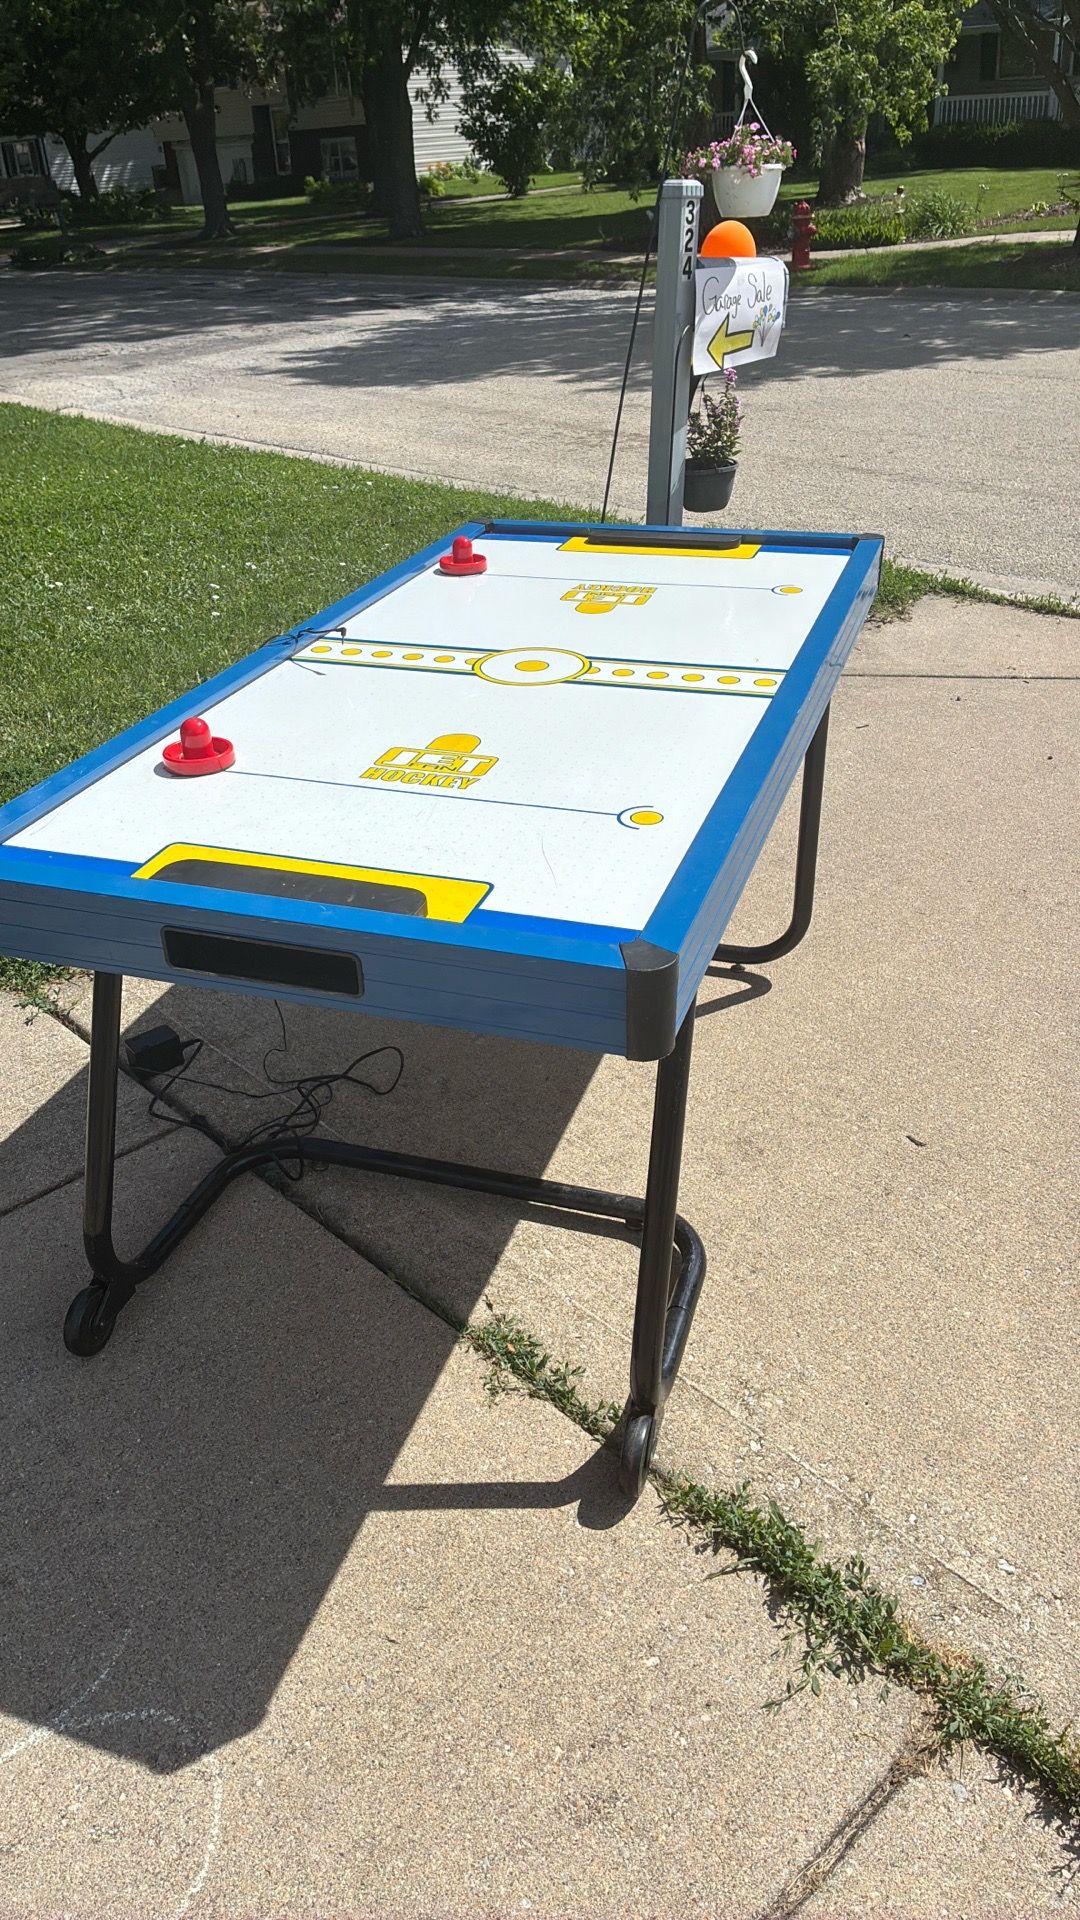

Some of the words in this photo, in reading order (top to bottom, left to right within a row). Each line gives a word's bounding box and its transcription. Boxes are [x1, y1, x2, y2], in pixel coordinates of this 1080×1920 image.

[683, 199, 696, 280] 324
[702, 276, 742, 319] Garage
[747, 271, 773, 309] Sale
[359, 766, 481, 790] HOCKEY
[380, 750, 492, 774] JET
